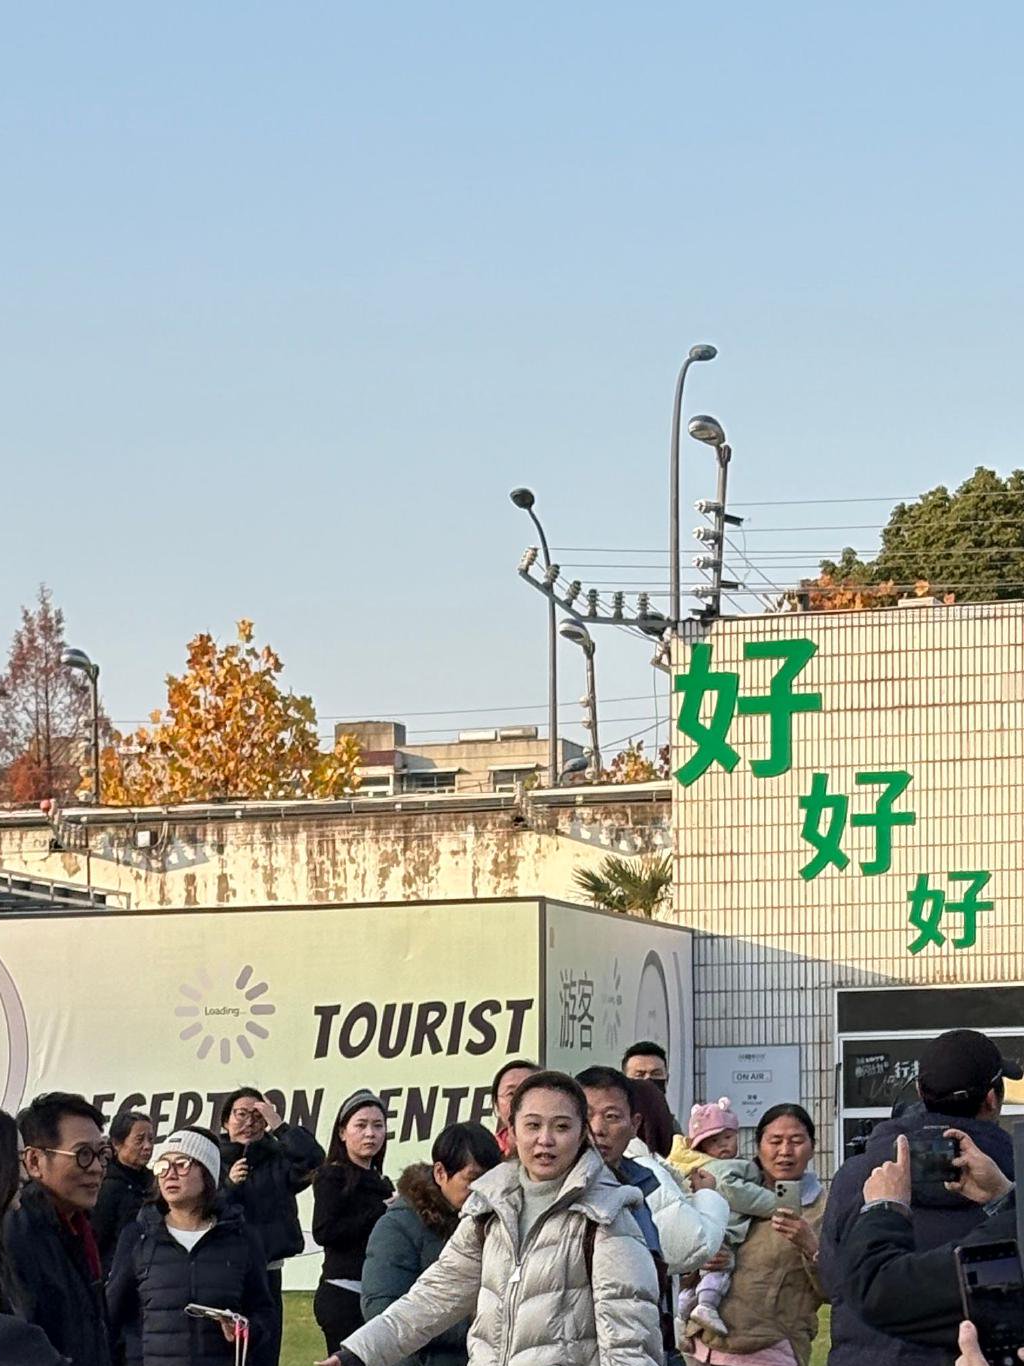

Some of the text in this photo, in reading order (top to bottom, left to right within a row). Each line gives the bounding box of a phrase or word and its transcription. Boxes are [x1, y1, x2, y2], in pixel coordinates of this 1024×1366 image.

[673, 638, 822, 788] 好
[798, 770, 916, 882] 好
[907, 870, 994, 955] 好
[313, 998, 535, 1060] TOURIST
[559, 968, 594, 1049] 游客
[736, 1072, 765, 1081] ON AIR
